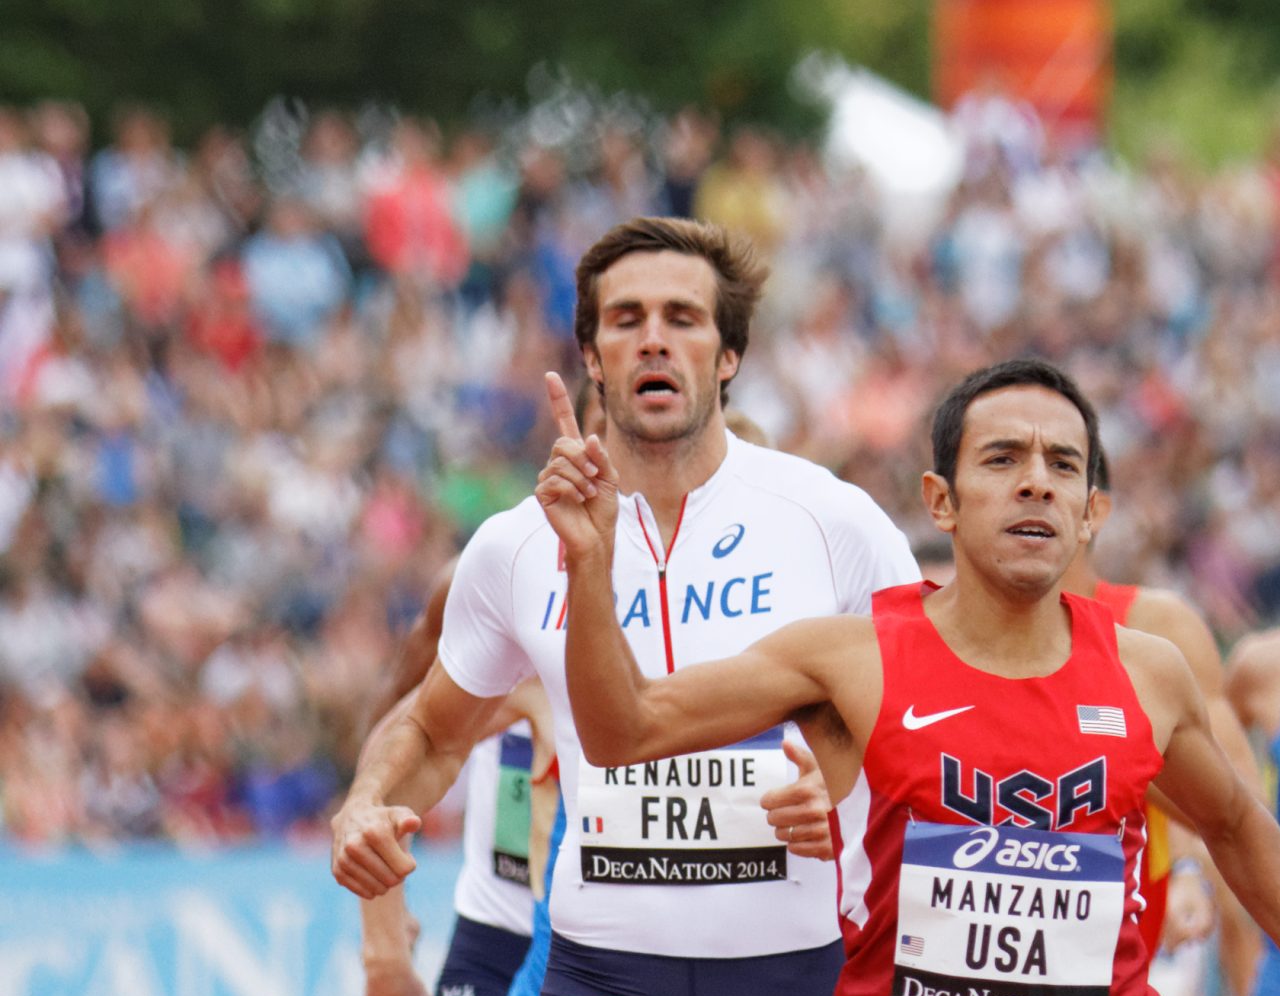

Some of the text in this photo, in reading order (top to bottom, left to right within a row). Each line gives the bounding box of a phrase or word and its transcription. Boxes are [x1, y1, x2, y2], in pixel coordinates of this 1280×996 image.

[563, 571, 774, 630] ANCE
[604, 758, 756, 787] RENAUDIE
[940, 751, 1107, 831] USA
[640, 795, 719, 840] FRA
[737, 859, 779, 880] 2014
[930, 876, 1092, 921] MANZANO
[964, 922, 1048, 976] USA
